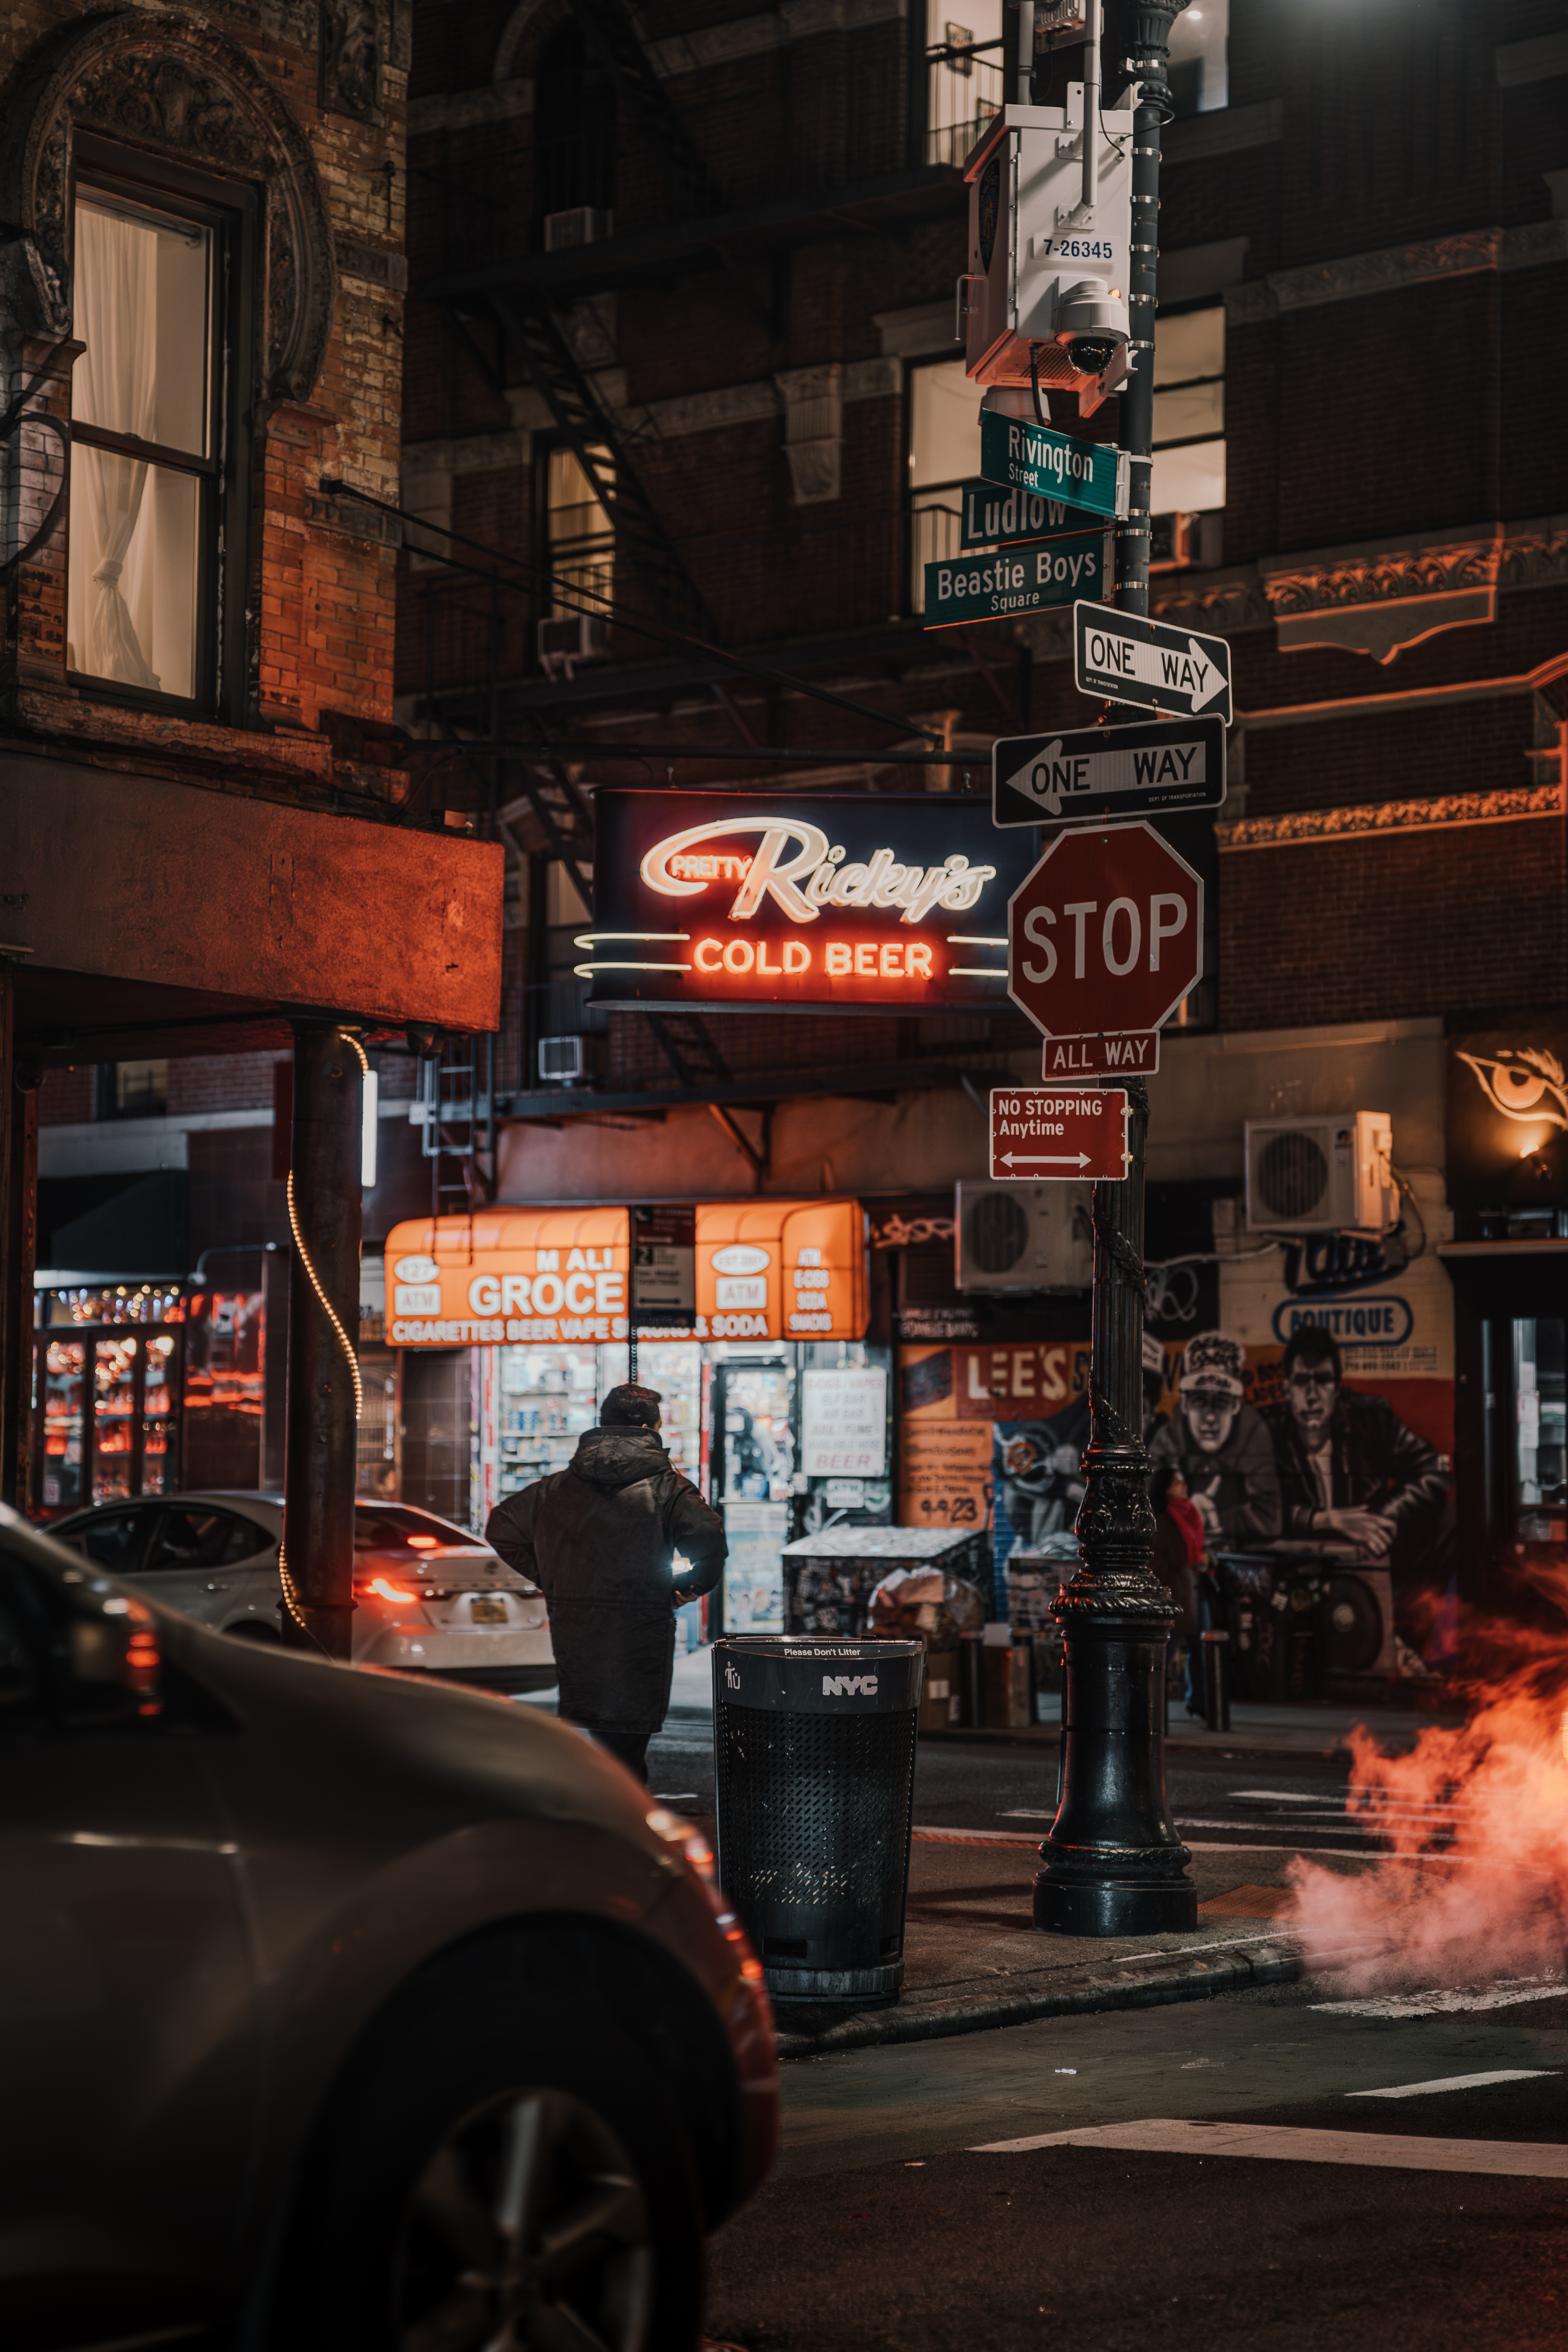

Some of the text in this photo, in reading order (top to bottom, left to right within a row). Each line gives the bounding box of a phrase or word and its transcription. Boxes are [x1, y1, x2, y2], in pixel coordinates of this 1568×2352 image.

[1043, 239, 1112, 258] 7-26345
[1008, 424, 1093, 484] Rivington
[1008, 463, 1039, 488] Street
[967, 488, 1067, 539] Ludlow
[938, 551, 1096, 600] Beastie Boys
[991, 592, 1040, 613] Square
[1091, 634, 1209, 693] ONE WAY
[1031, 746, 1197, 796] ONE WAY
[1169, 791, 1206, 800] TRANSPORTATION
[671, 855, 754, 880] PRETTY
[1022, 893, 1188, 984] STOP
[694, 939, 934, 980] COLD BEER
[1053, 1039, 1149, 1070] ALL WAY
[999, 1099, 1102, 1116] NO STOPPING
[999, 1119, 1065, 1139] Anytime
[566, 1247, 612, 1271] ALI
[401, 1291, 434, 1308] ATM
[724, 1284, 758, 1301] ATM
[392, 1319, 505, 1342] CIGARETTES
[506, 1318, 559, 1341] BEER
[559, 1317, 609, 1340] VAPE
[711, 1314, 769, 1337] SODA
[1290, 1306, 1394, 1337] BOUTIQUE
[968, 1346, 1067, 1401] LEE'S
[815, 1453, 871, 1469] BEER
[784, 1648, 861, 1656] Please Don't Litter
[822, 1675, 878, 1696] NYC
